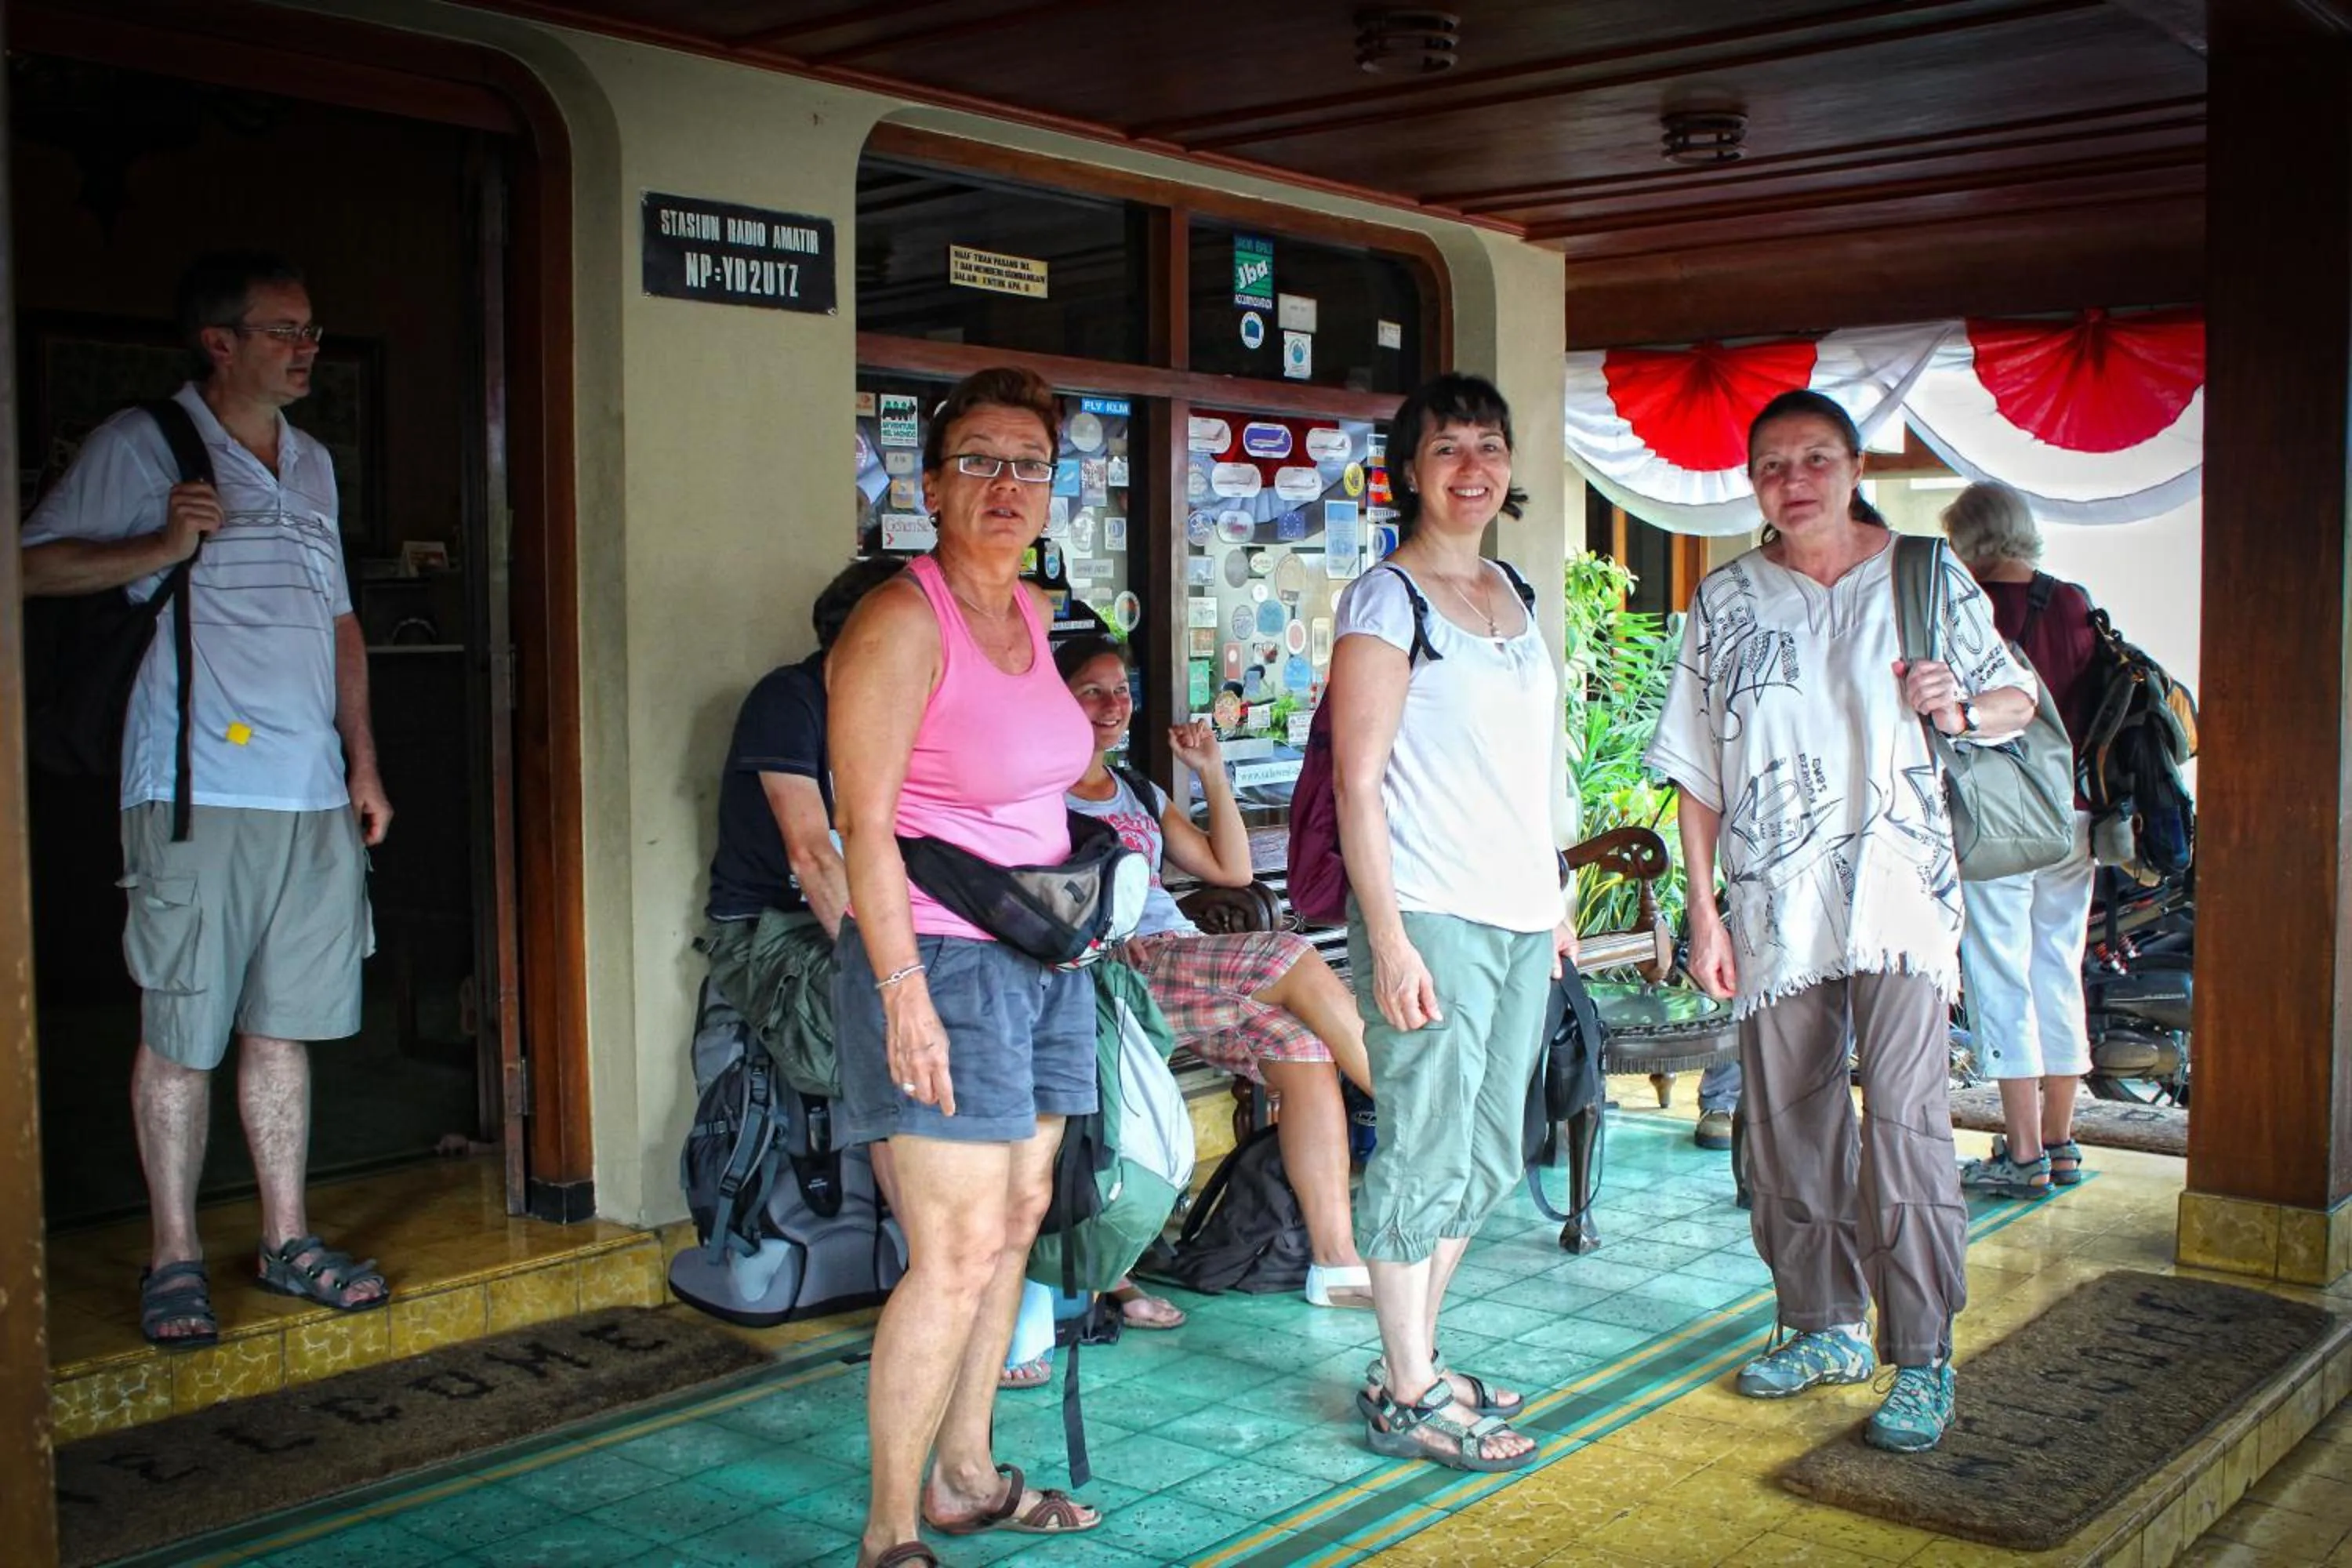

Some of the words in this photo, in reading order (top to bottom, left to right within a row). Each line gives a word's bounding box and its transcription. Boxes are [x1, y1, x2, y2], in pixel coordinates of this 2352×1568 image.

[660, 209, 720, 242] STASIUN
[727, 217, 766, 248] RADIO
[772, 224, 819, 255] AMATIR
[1084, 400, 1102, 412] FLY
